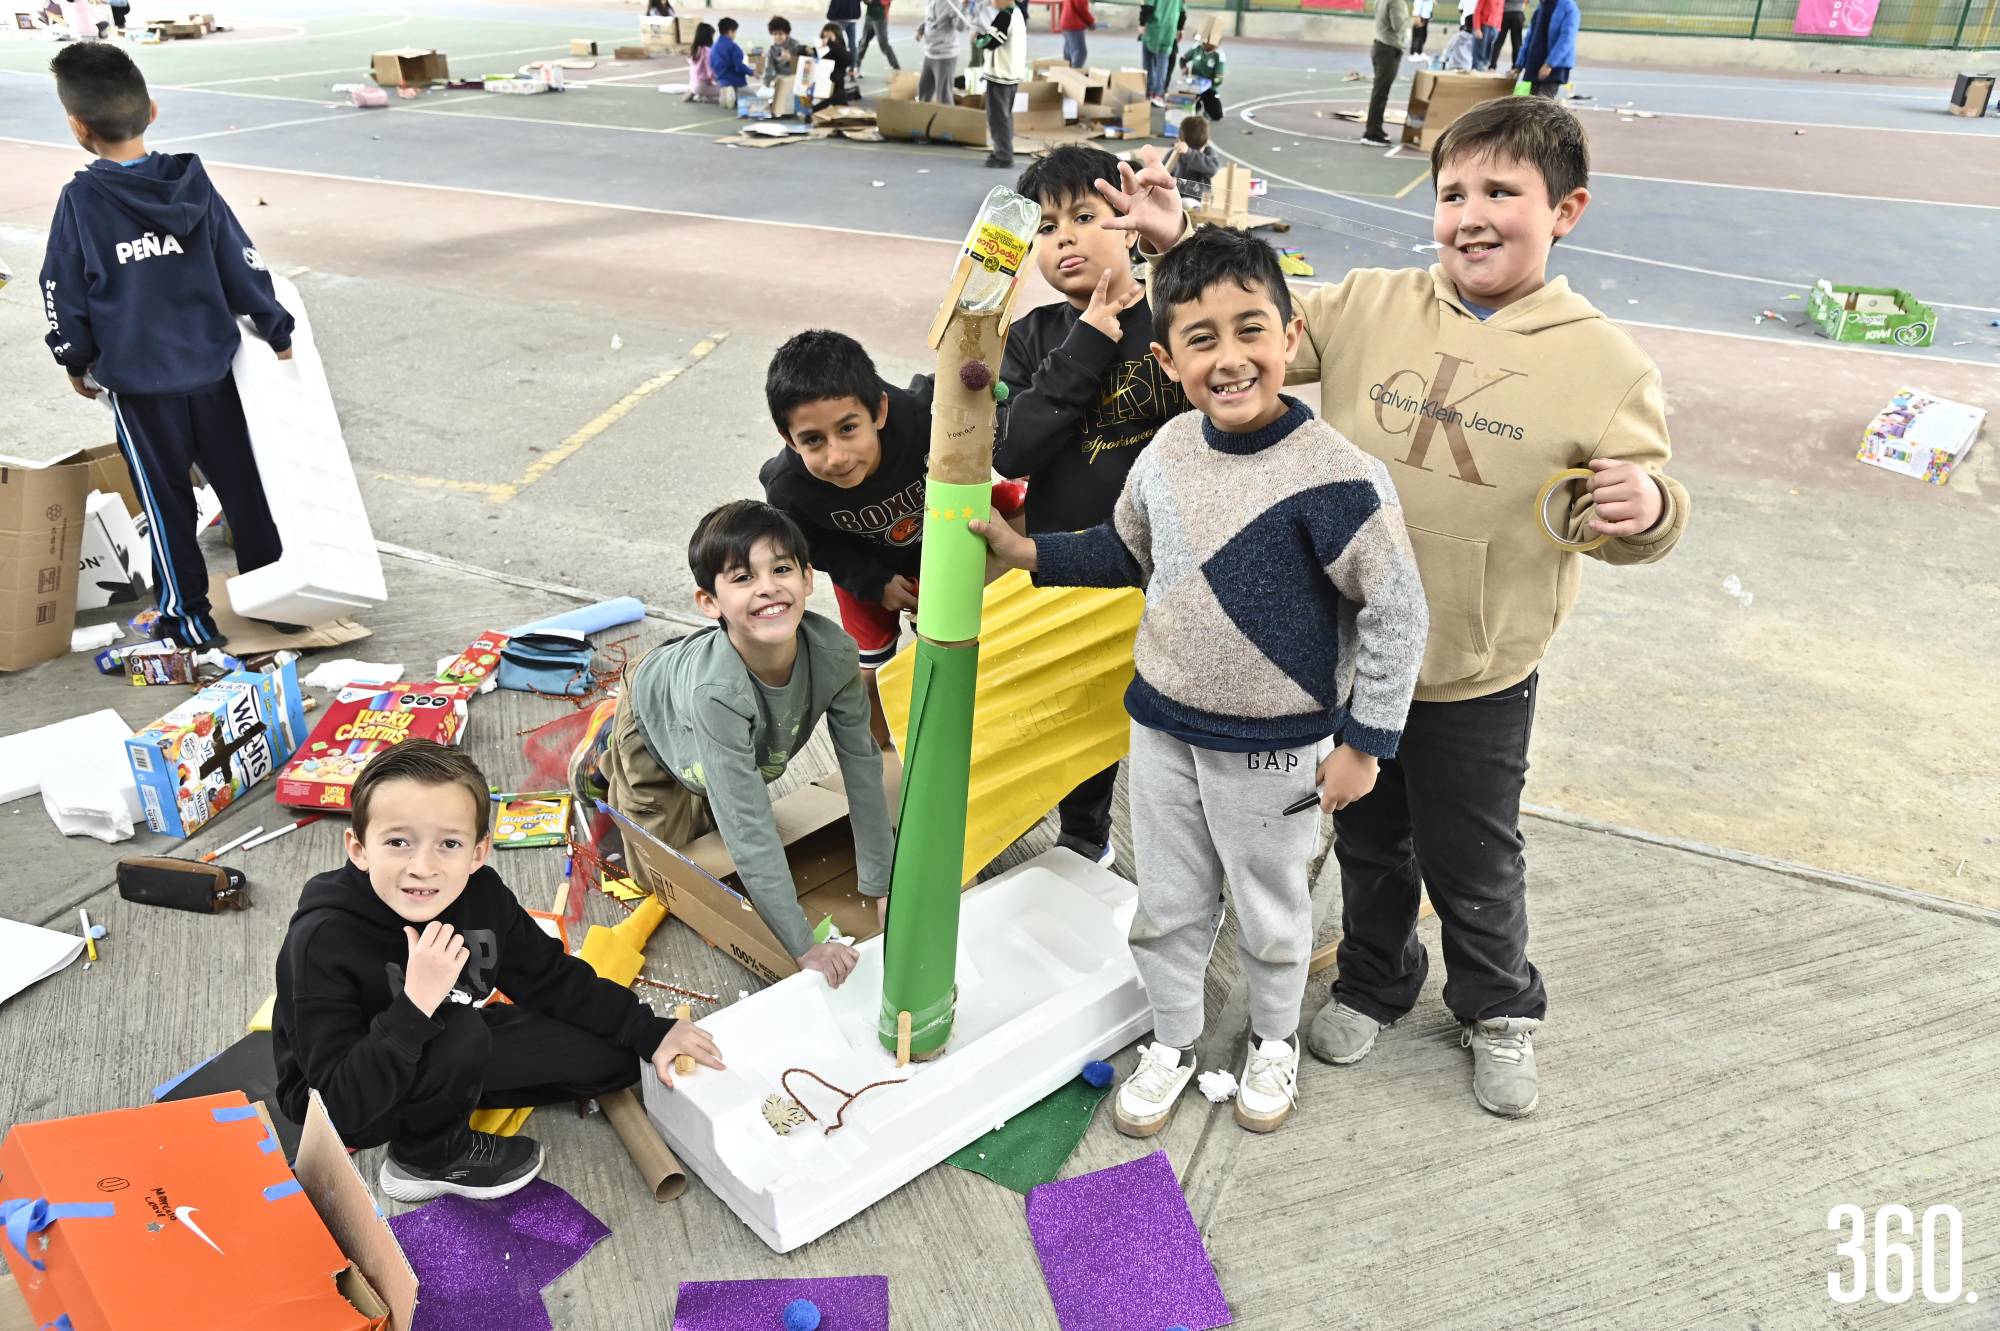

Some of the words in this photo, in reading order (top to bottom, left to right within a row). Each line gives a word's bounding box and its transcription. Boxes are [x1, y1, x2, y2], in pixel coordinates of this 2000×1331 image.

[115, 232, 184, 264] PEÑA
[976, 237, 1000, 255] Chico
[999, 248, 1018, 266] Topo
[1369, 384, 1418, 414] Calvin
[1419, 398, 1463, 426] Klein
[1465, 412, 1524, 440] Jeans
[1375, 352, 1528, 488] CK
[1082, 427, 1159, 464] Sportswea
[830, 473, 926, 532] BOXE
[353, 709, 416, 730] Lucky
[233, 695, 267, 778] Wech's
[335, 724, 410, 745] Charms
[1247, 751, 1298, 772] GAP
[320, 794, 346, 806] Charms
[324, 785, 346, 796] Lucky
[730, 944, 759, 972] 100%
